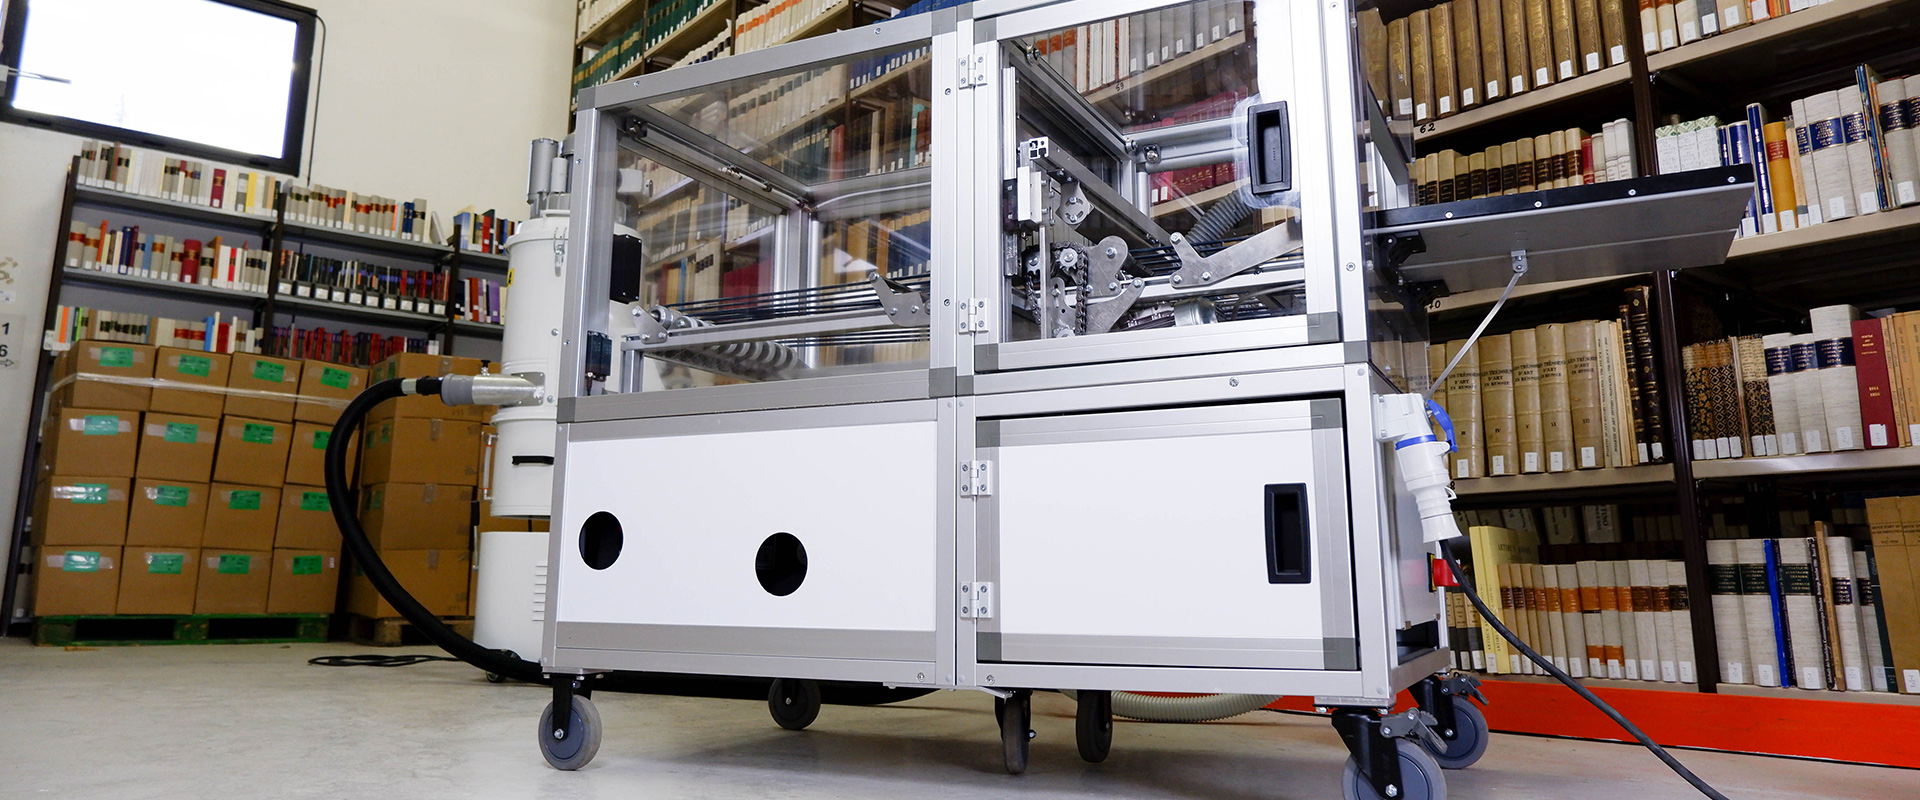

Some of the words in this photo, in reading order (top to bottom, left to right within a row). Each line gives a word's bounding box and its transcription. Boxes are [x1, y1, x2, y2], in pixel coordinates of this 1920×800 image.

[1420, 122, 1436, 134] 62
[2, 322, 10, 335] 1
[0, 344, 8, 357] 6
